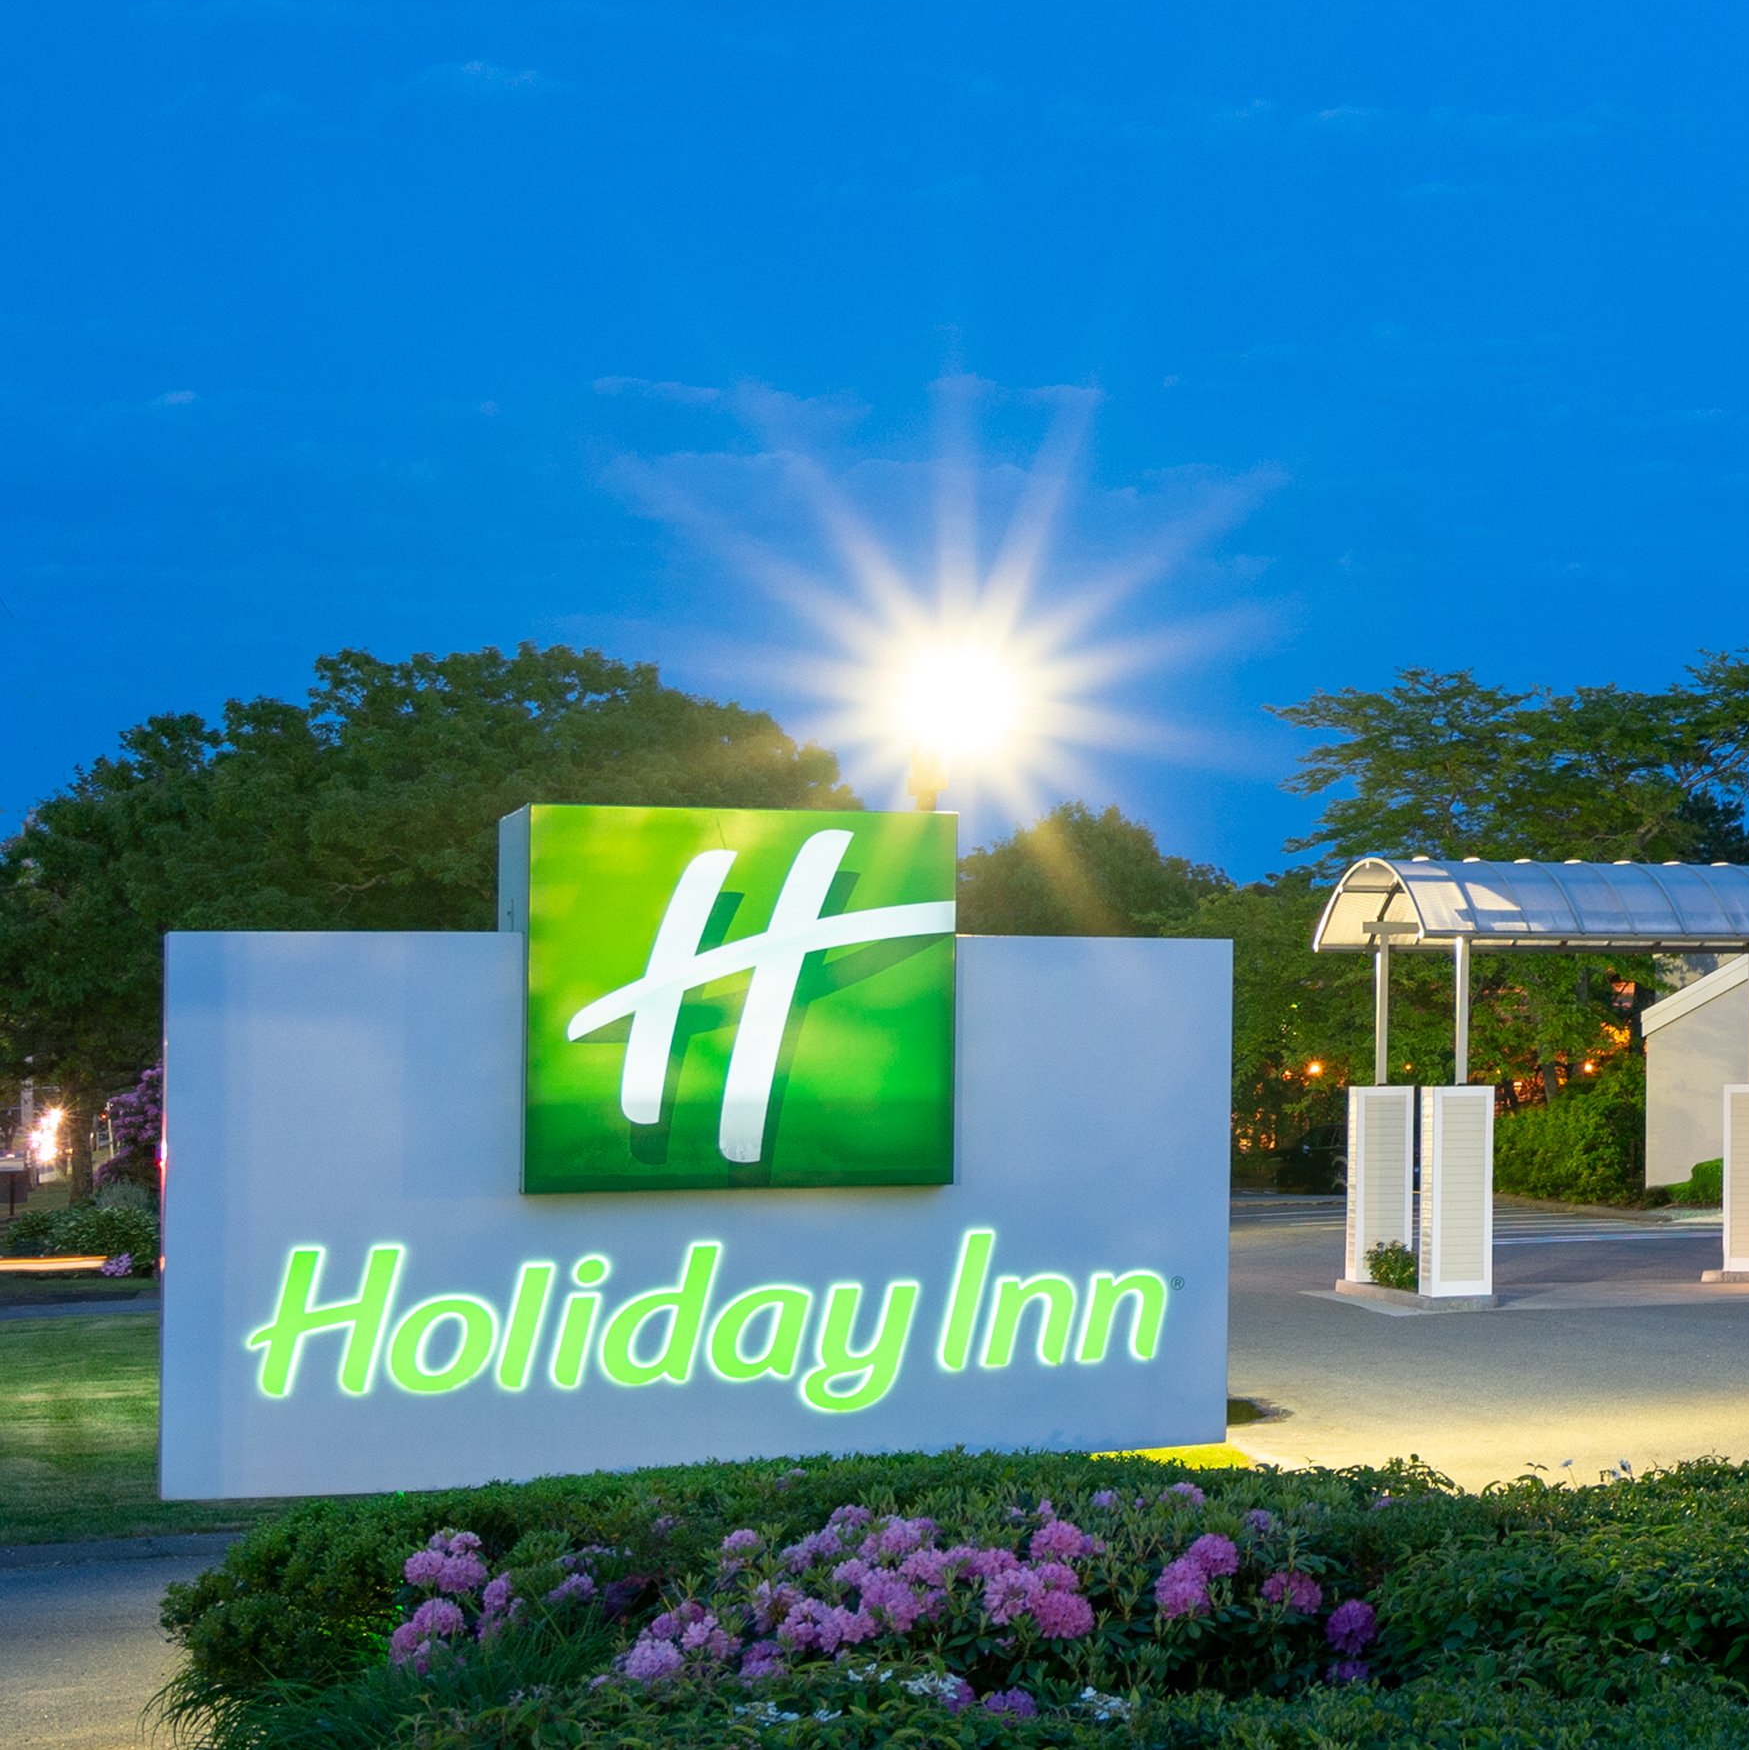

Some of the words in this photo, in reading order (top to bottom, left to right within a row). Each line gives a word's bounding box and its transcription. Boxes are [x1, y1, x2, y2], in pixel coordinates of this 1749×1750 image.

[568, 829, 956, 1163] H
[249, 1244, 919, 1413] Holiday
[936, 1229, 1168, 1372] Inn
